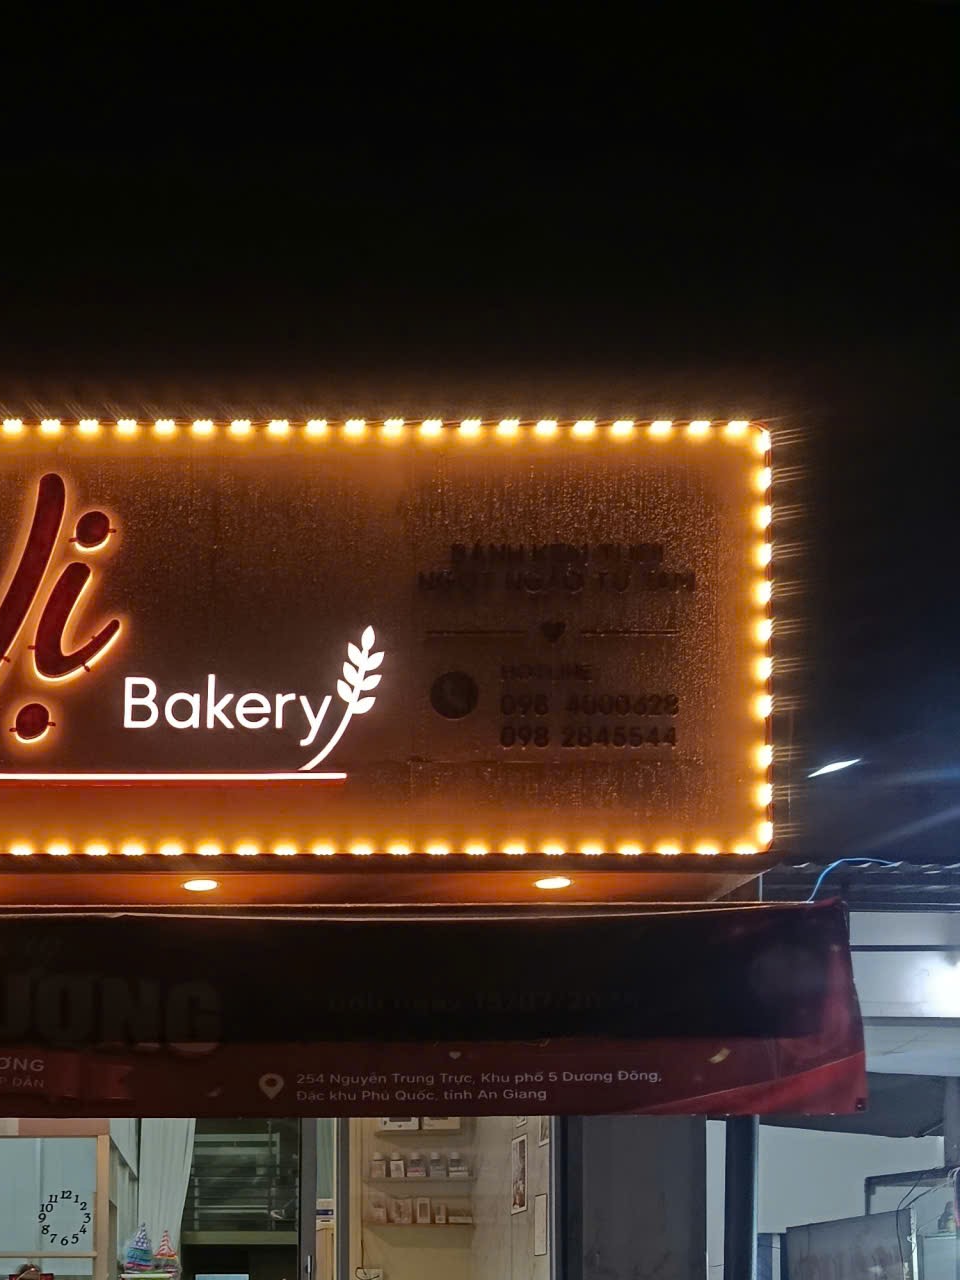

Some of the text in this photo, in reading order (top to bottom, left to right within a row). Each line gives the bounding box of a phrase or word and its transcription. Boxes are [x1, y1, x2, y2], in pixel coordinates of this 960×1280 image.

[123, 674, 332, 746] Bakery
[296, 1073, 325, 1084] 254
[392, 1073, 435, 1086] Trung
[481, 1072, 510, 1084] Khu
[548, 1072, 558, 1083] 5
[329, 1090, 356, 1101] khu
[478, 1089, 497, 1100] An
[503, 1088, 546, 1101] Giang
[48, 1194, 58, 1203] 11
[60, 1190, 72, 1199] 12
[73, 1194, 79, 1203] 1
[40, 1203, 53, 1213] 10
[80, 1201, 87, 1210] 2
[38, 1212, 46, 1223] 9
[83, 1213, 91, 1223] 3
[41, 1224, 50, 1235] 8
[79, 1224, 87, 1234] 4
[50, 1233, 58, 1243] 7
[60, 1236, 69, 1246] 6
[71, 1233, 79, 1244] 5
